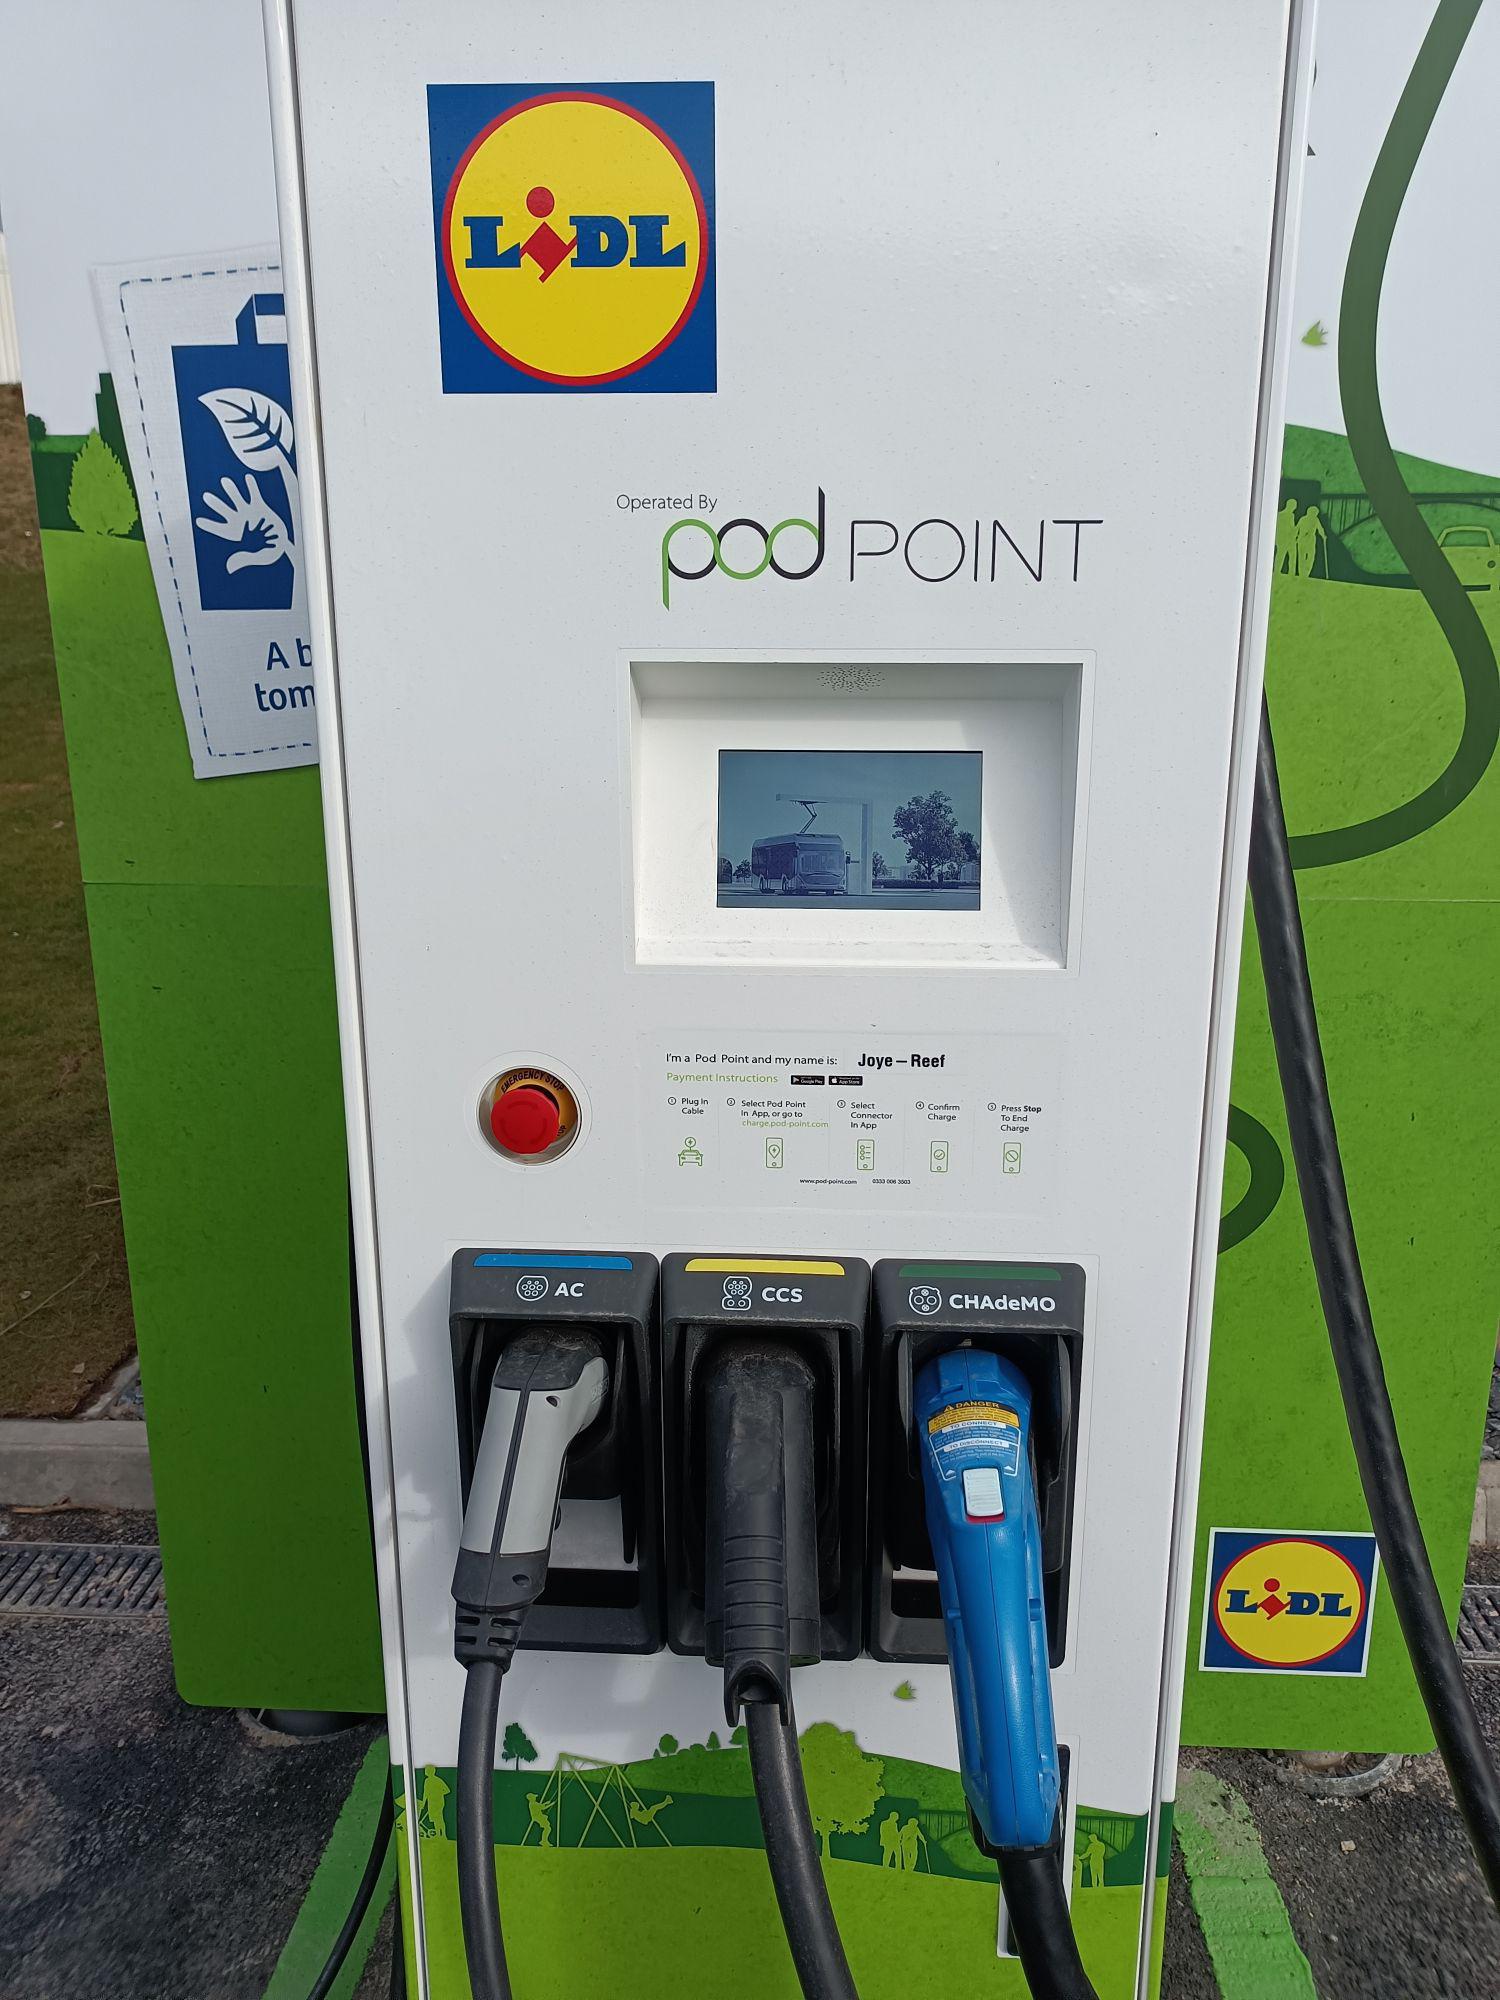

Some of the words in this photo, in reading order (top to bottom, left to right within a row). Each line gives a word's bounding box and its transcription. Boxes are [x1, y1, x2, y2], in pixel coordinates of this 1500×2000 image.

[616, 493, 693, 513] Operated
[699, 494, 718, 513] By
[661, 486, 825, 611] pod
[849, 518, 1104, 583] POINT
[267, 641, 290, 671] A
[666, 1053, 682, 1063] I'm
[684, 1055, 691, 1063] a
[695, 1054, 717, 1063] Pod
[721, 1054, 749, 1064] Point
[751, 1055, 772, 1064] and
[774, 1056, 792, 1067] my
[794, 1057, 824, 1065] name
[826, 1056, 838, 1065] is:
[857, 1053, 893, 1070] Joye
[910, 1054, 946, 1068] Reef
[500, 1070, 545, 1093] EMERGENCY
[545, 1075, 566, 1091] STOP
[666, 1072, 713, 1084] Payment
[715, 1073, 779, 1083] Instructions
[681, 1097, 699, 1106] Plug
[741, 1100, 765, 1108] Select
[766, 1100, 783, 1108] Pod
[785, 1100, 806, 1108] Point
[681, 1107, 705, 1115] Cable
[927, 1103, 960, 1111] Confirm
[1023, 1105, 1042, 1114] Stop
[751, 1110, 770, 1118] App,
[782, 1111, 792, 1119] go
[794, 1110, 803, 1118] to
[850, 1112, 893, 1120] Connector
[927, 1113, 957, 1122] Charge
[742, 1119, 829, 1129] charge.pod-point.com
[850, 1121, 859, 1129] In
[860, 1122, 878, 1131] App
[1000, 1124, 1030, 1133] Charge
[554, 1282, 585, 1298] AC
[761, 1287, 803, 1303] CCS
[949, 1293, 1056, 1312] CHAdeMO
[955, 1401, 1000, 1409] DANGER
[959, 1439, 1003, 1447] DISCONNECT
